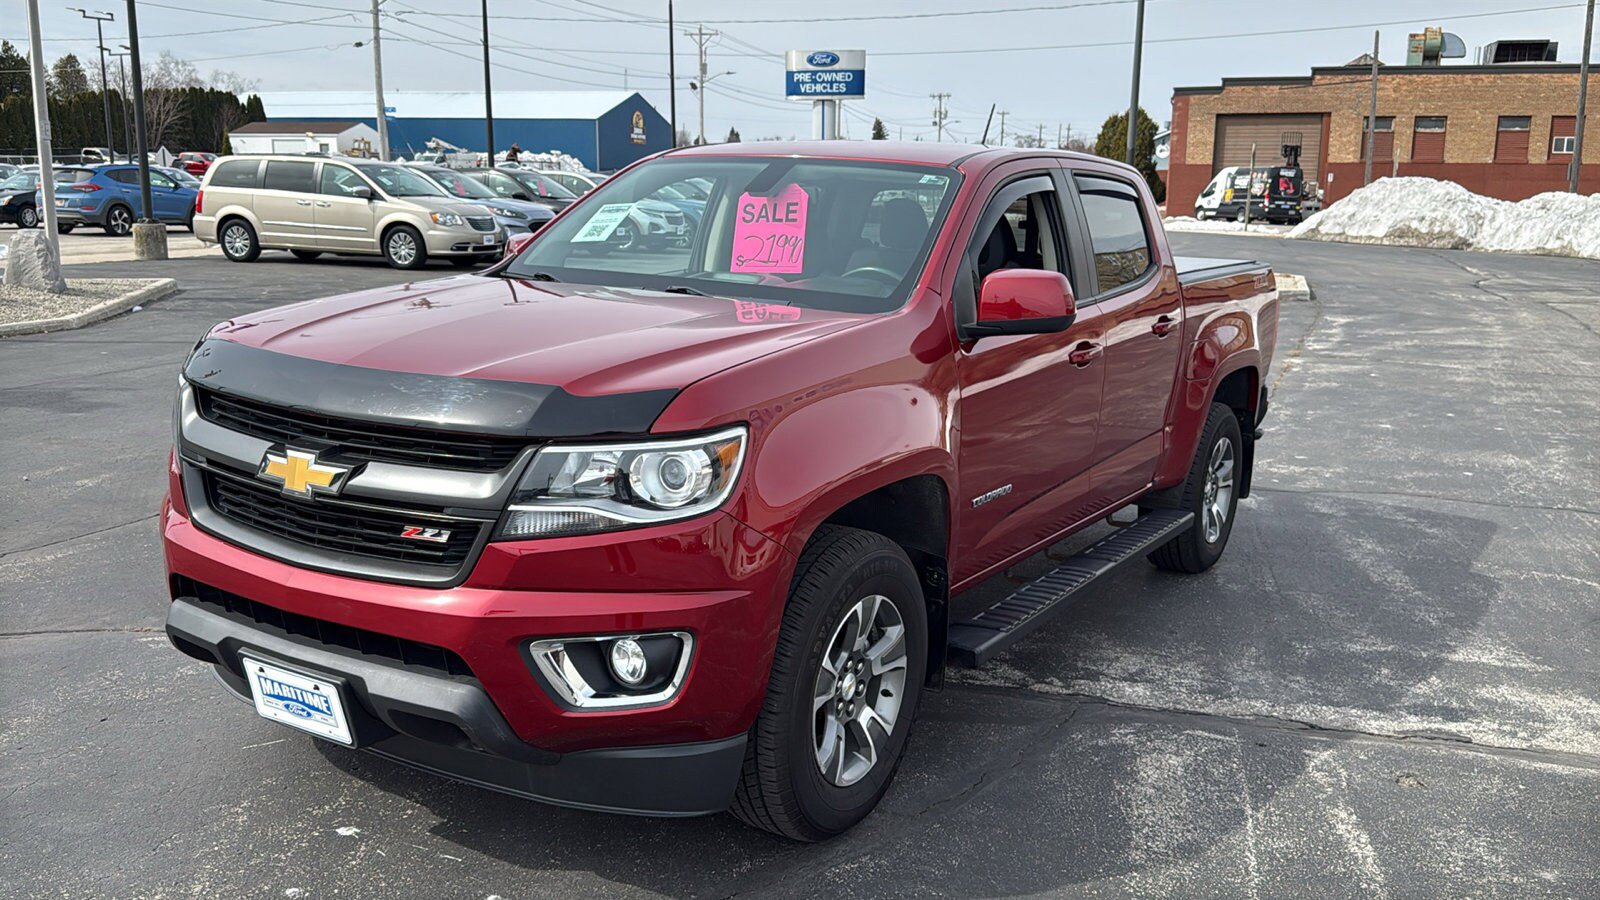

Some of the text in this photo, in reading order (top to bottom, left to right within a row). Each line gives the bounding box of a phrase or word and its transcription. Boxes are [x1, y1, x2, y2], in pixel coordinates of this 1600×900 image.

[812, 54, 833, 65] Ford
[799, 83, 847, 93] VEHICLES
[742, 202, 799, 224] SALE
[972, 483, 1013, 508] COLORADO
[400, 525, 451, 543] Z71
[259, 677, 332, 714] MARITIME
[288, 704, 308, 717] Ford
